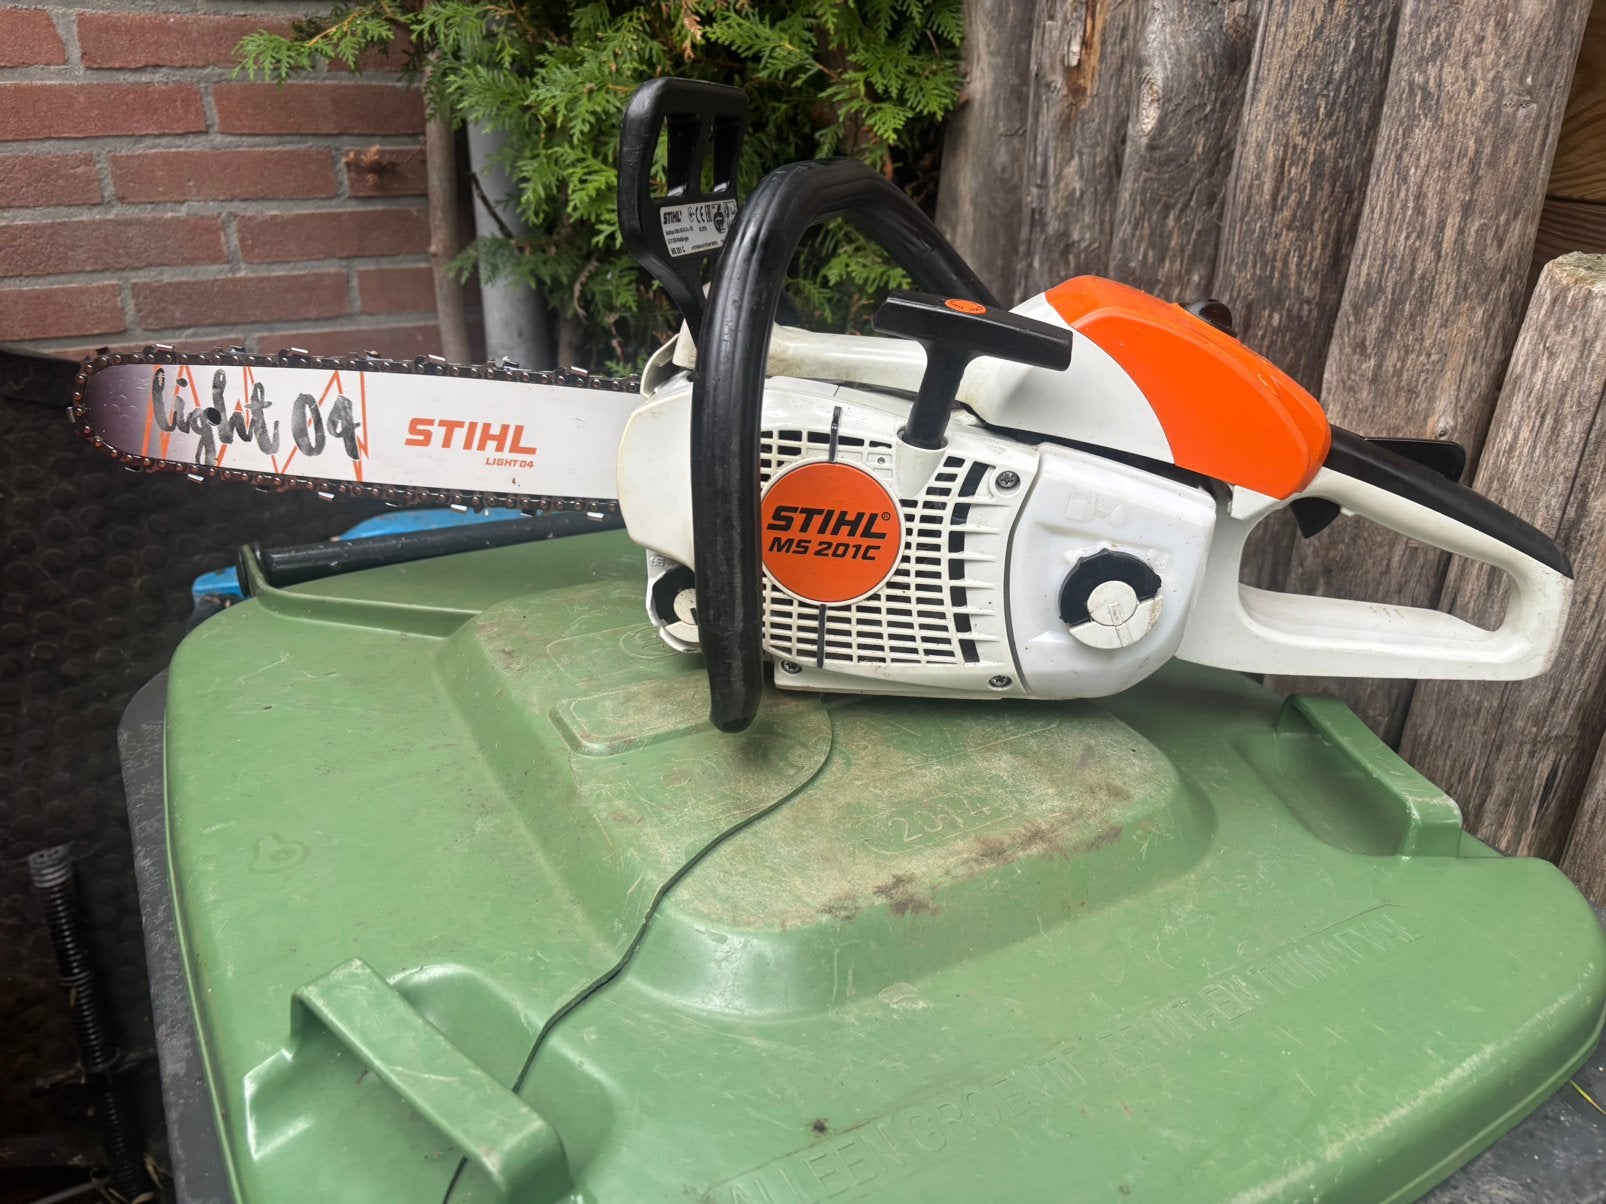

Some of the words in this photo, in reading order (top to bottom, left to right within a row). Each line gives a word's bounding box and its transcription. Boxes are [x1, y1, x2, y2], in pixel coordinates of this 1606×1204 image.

[663, 210, 682, 225] STIHL
[404, 417, 538, 455] STIHL
[768, 537, 812, 555] MS
[813, 541, 881, 561] 201C
